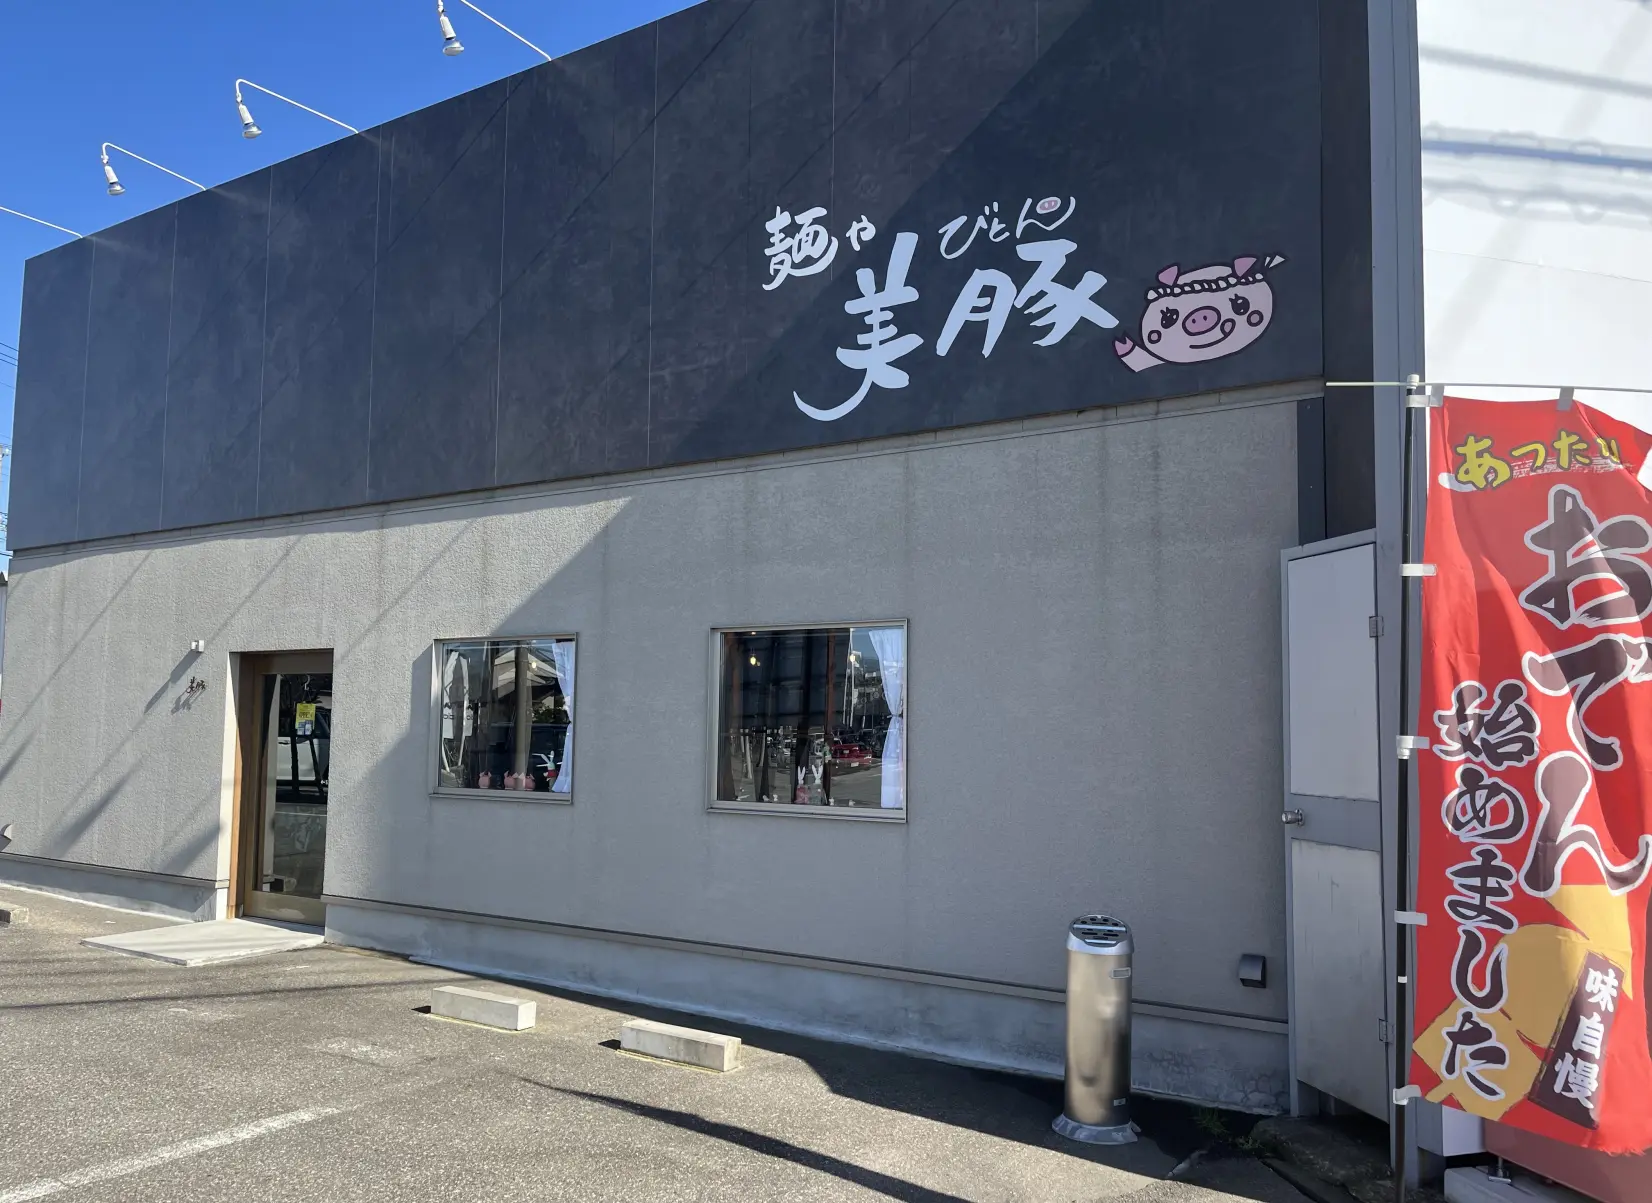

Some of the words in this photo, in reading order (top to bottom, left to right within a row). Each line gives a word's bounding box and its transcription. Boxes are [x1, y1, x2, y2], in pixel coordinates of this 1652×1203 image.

[762, 205, 876, 291] 麺や
[939, 196, 1076, 260] びとん
[793, 231, 1120, 422] 美豚
[1518, 484, 1652, 898] おでん
[1433, 680, 1540, 1099] 始めました
[1553, 967, 1620, 1109] 味自慢
